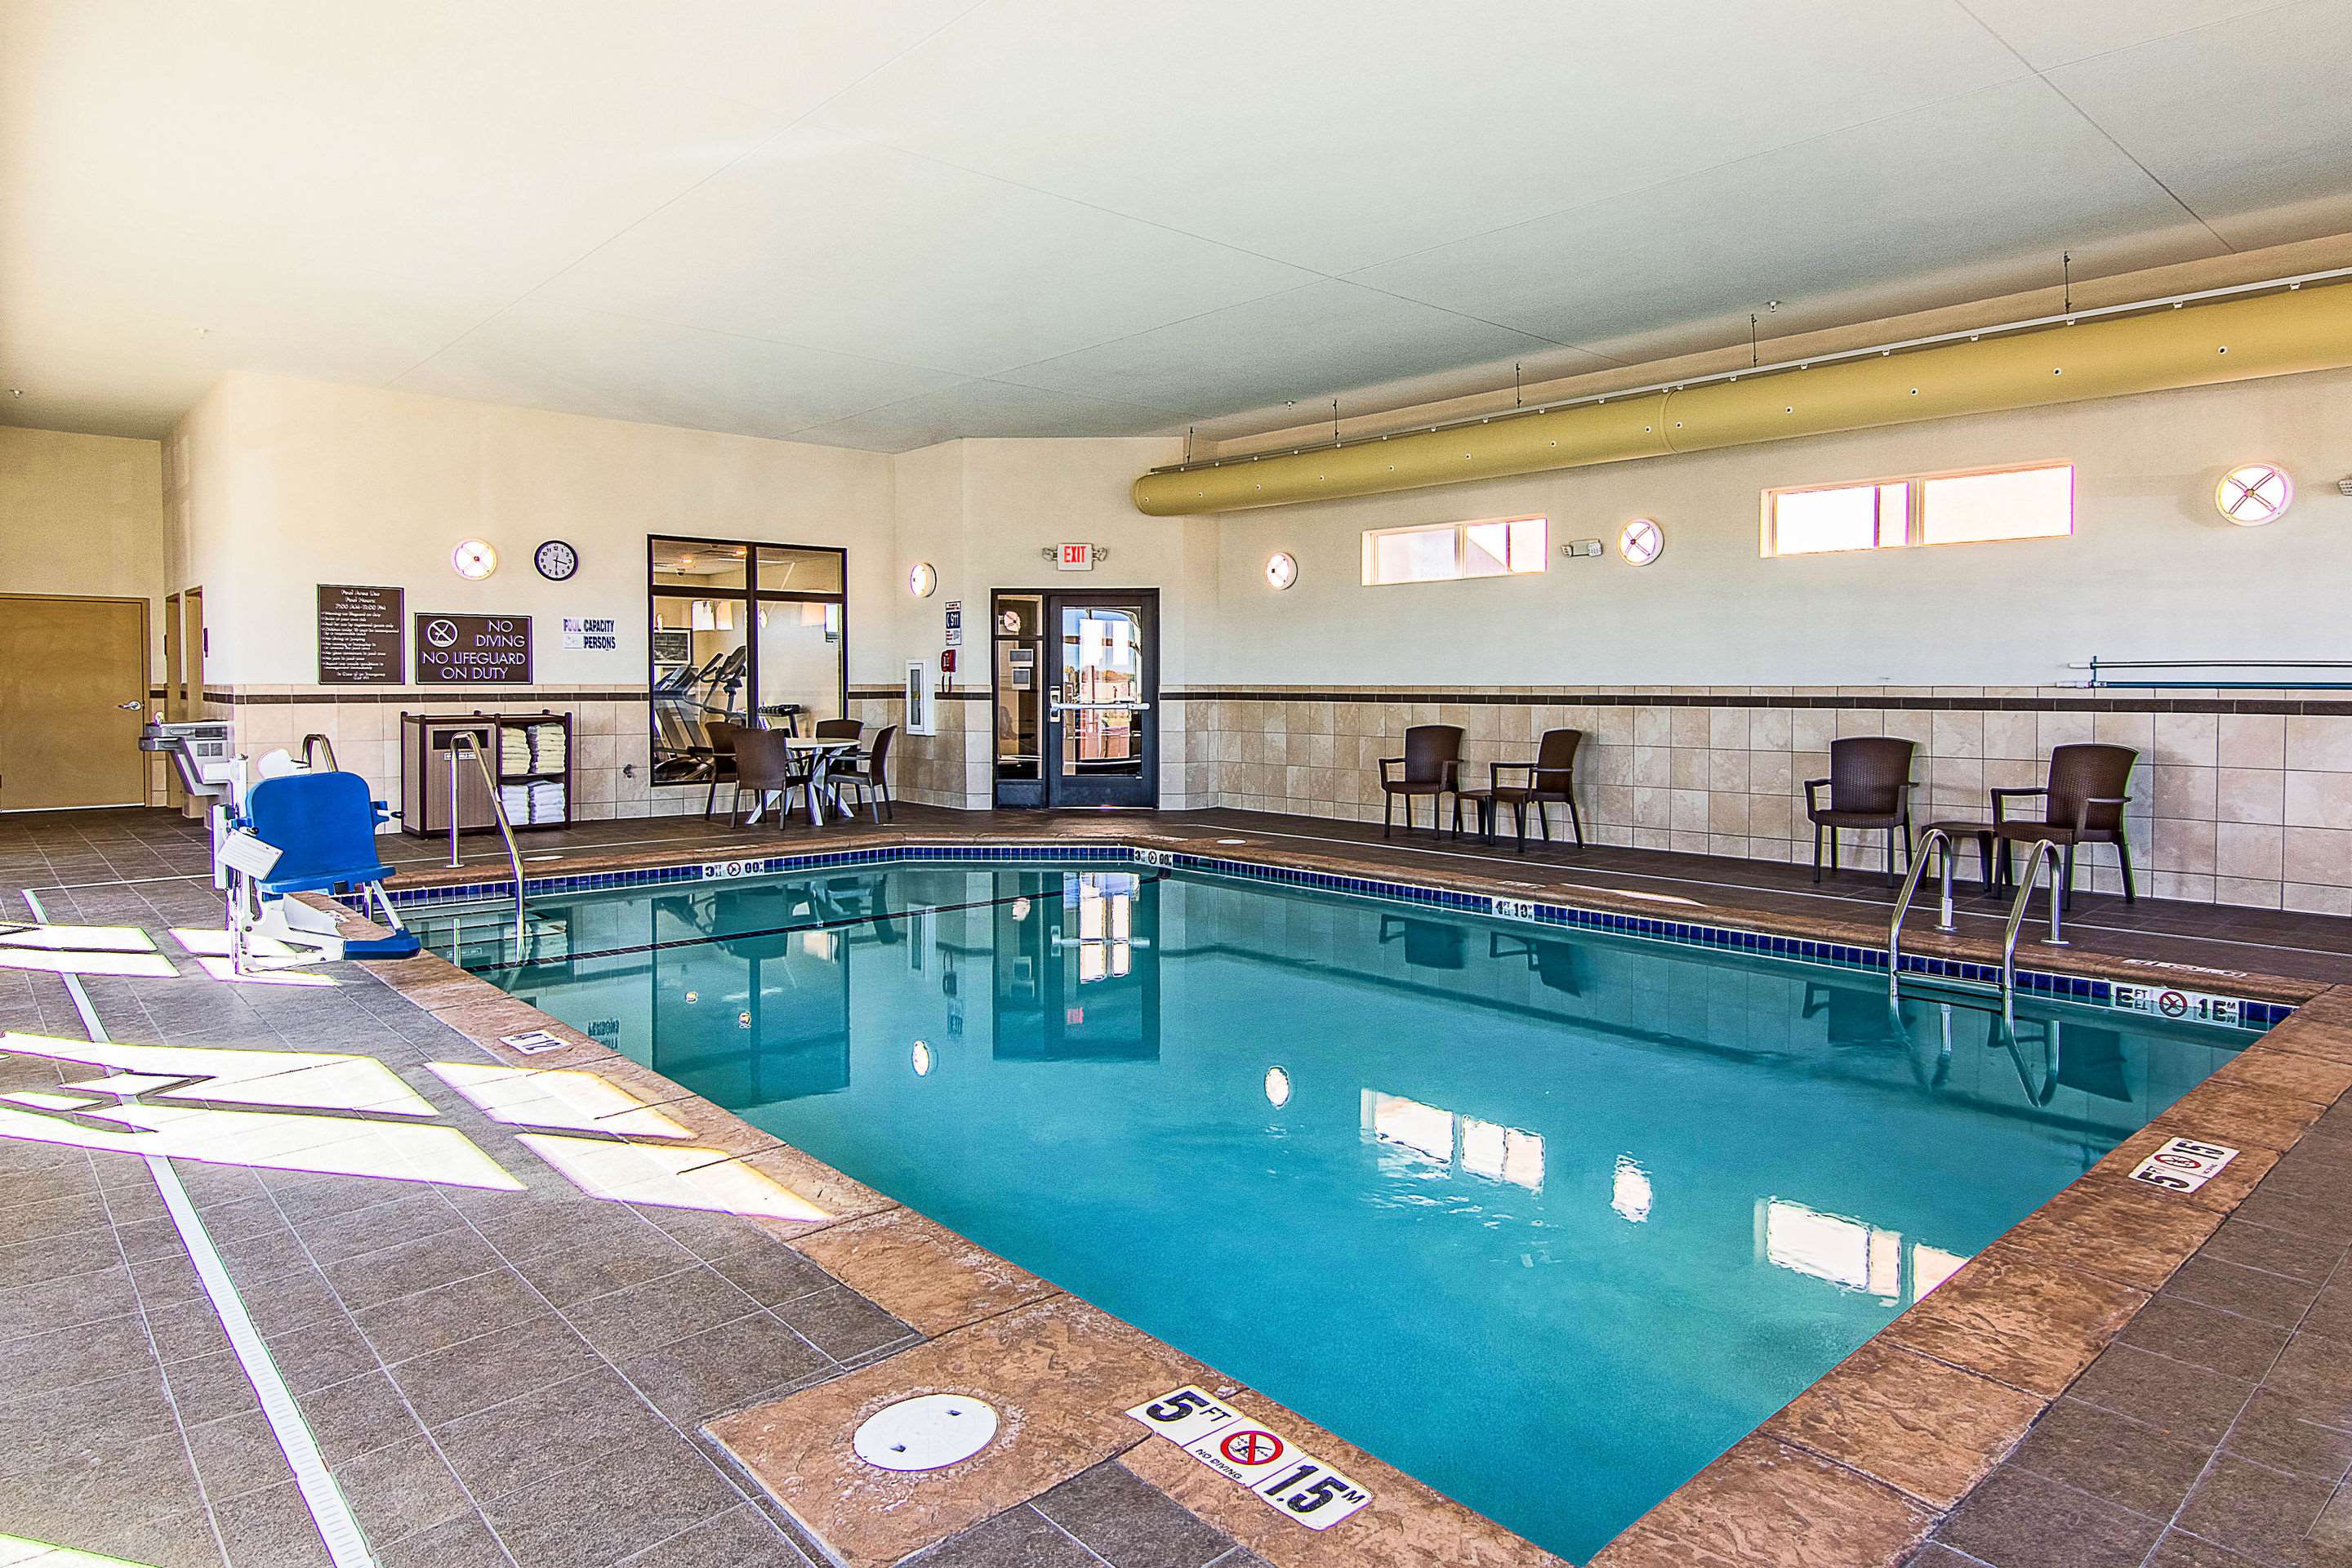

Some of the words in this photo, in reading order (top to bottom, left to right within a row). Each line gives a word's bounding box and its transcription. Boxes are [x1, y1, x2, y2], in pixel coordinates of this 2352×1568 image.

[1064, 546, 1086, 563] EXIT
[488, 621, 513, 632] NO
[584, 619, 614, 632] CAPACITY
[476, 635, 525, 647] DIVING
[583, 635, 616, 649] PERSONS
[422, 653, 448, 664] NO
[454, 653, 525, 664] LIFEGUARD
[442, 667, 467, 679] ON
[473, 667, 508, 679] DUTY
[2136, 1171, 2189, 1188] 5
[1146, 1391, 1210, 1422] 5
[1199, 1406, 1232, 1422] FT
[1195, 1449, 1213, 1460] NO
[1209, 1458, 1243, 1480] DIVING
[1263, 1464, 1350, 1513] 1.5
[1341, 1490, 1365, 1504] M
